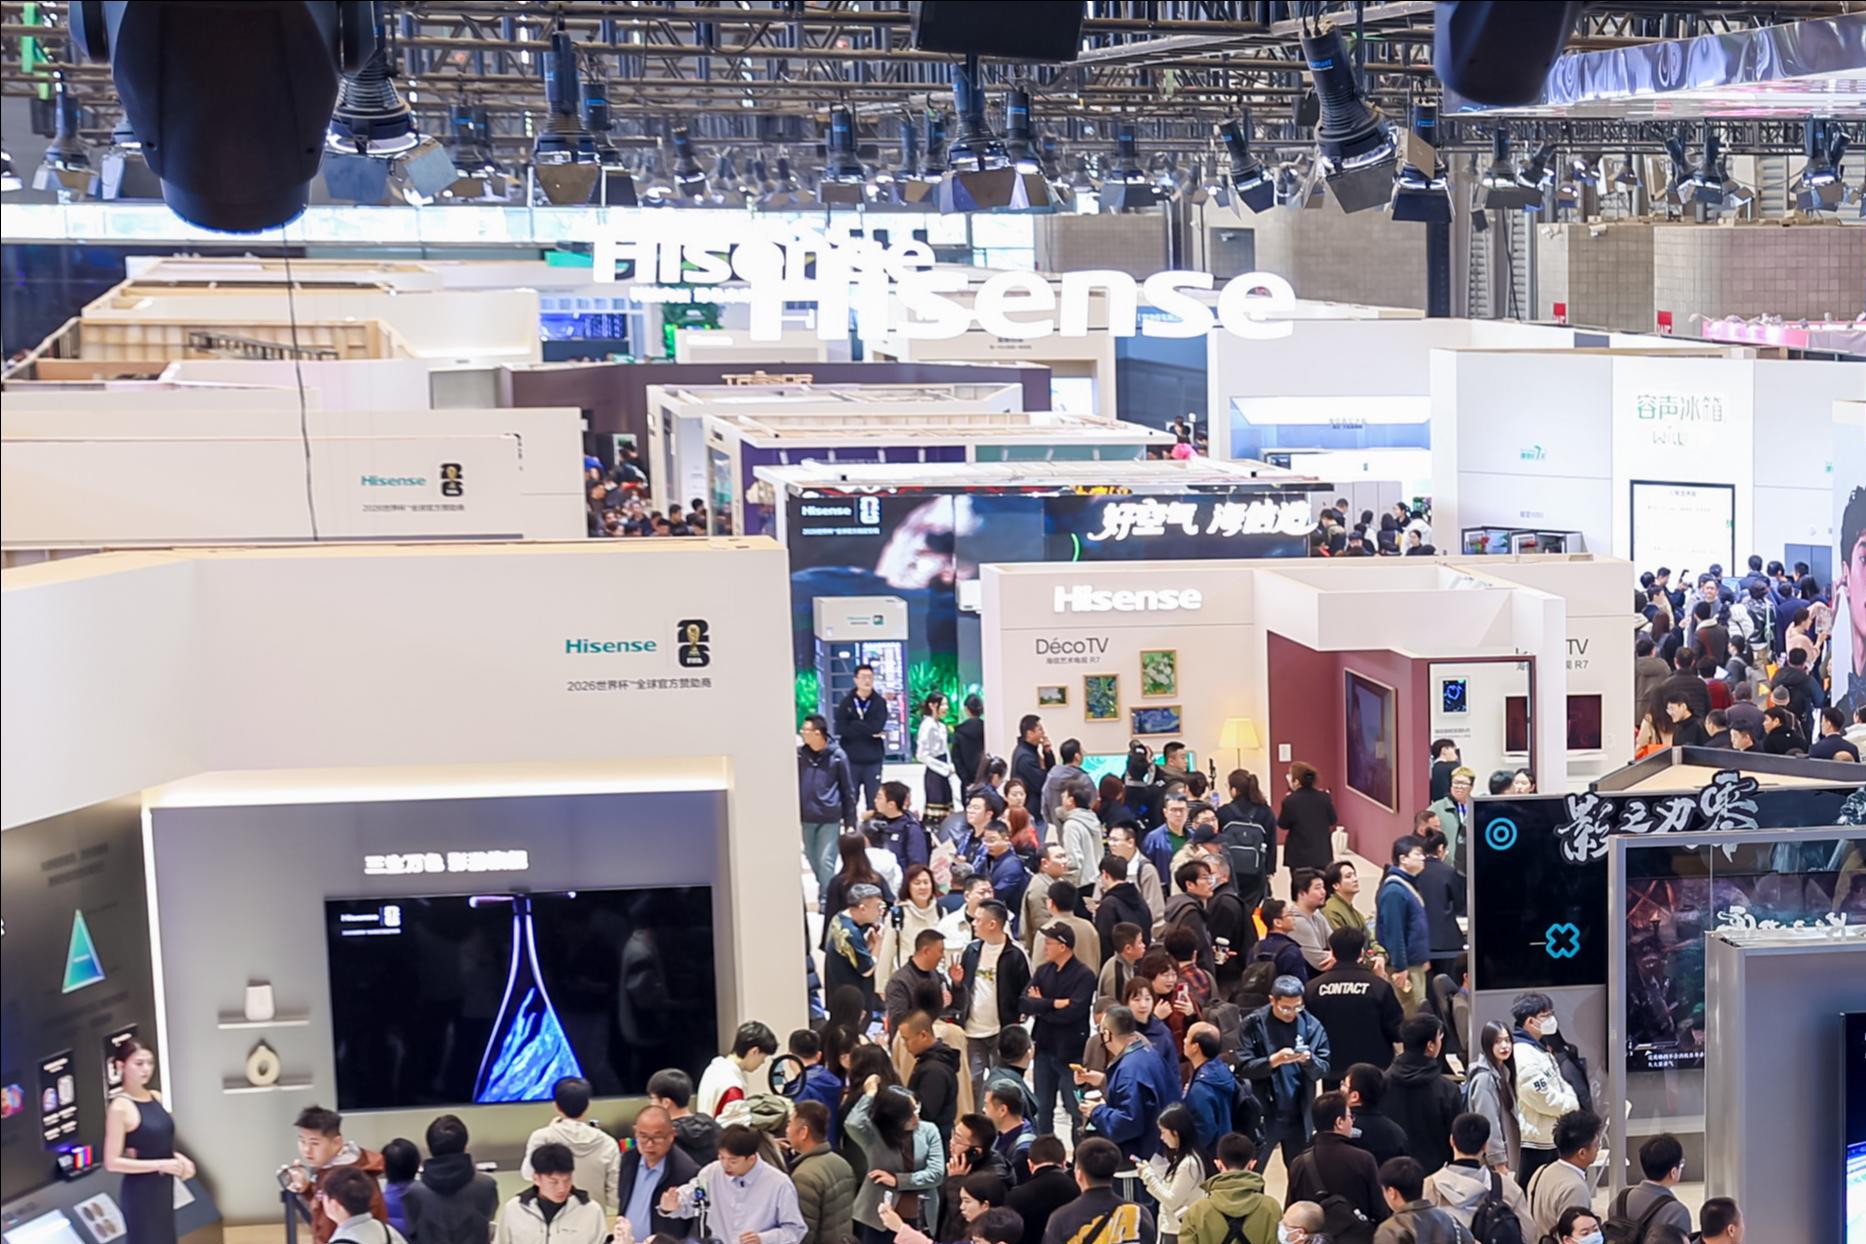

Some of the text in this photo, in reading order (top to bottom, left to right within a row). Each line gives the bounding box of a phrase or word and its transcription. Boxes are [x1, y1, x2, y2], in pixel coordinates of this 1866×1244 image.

[750, 262, 1297, 340] Hisense
[1637, 394, 1723, 422] 容声冰箱
[361, 475, 427, 487] Hisense
[801, 505, 852, 517] Hisense
[1053, 585, 1202, 613] Hisense
[565, 639, 657, 654] Hisense
[1035, 637, 1109, 655] DécoTV
[1319, 982, 1370, 996] CONTACT
